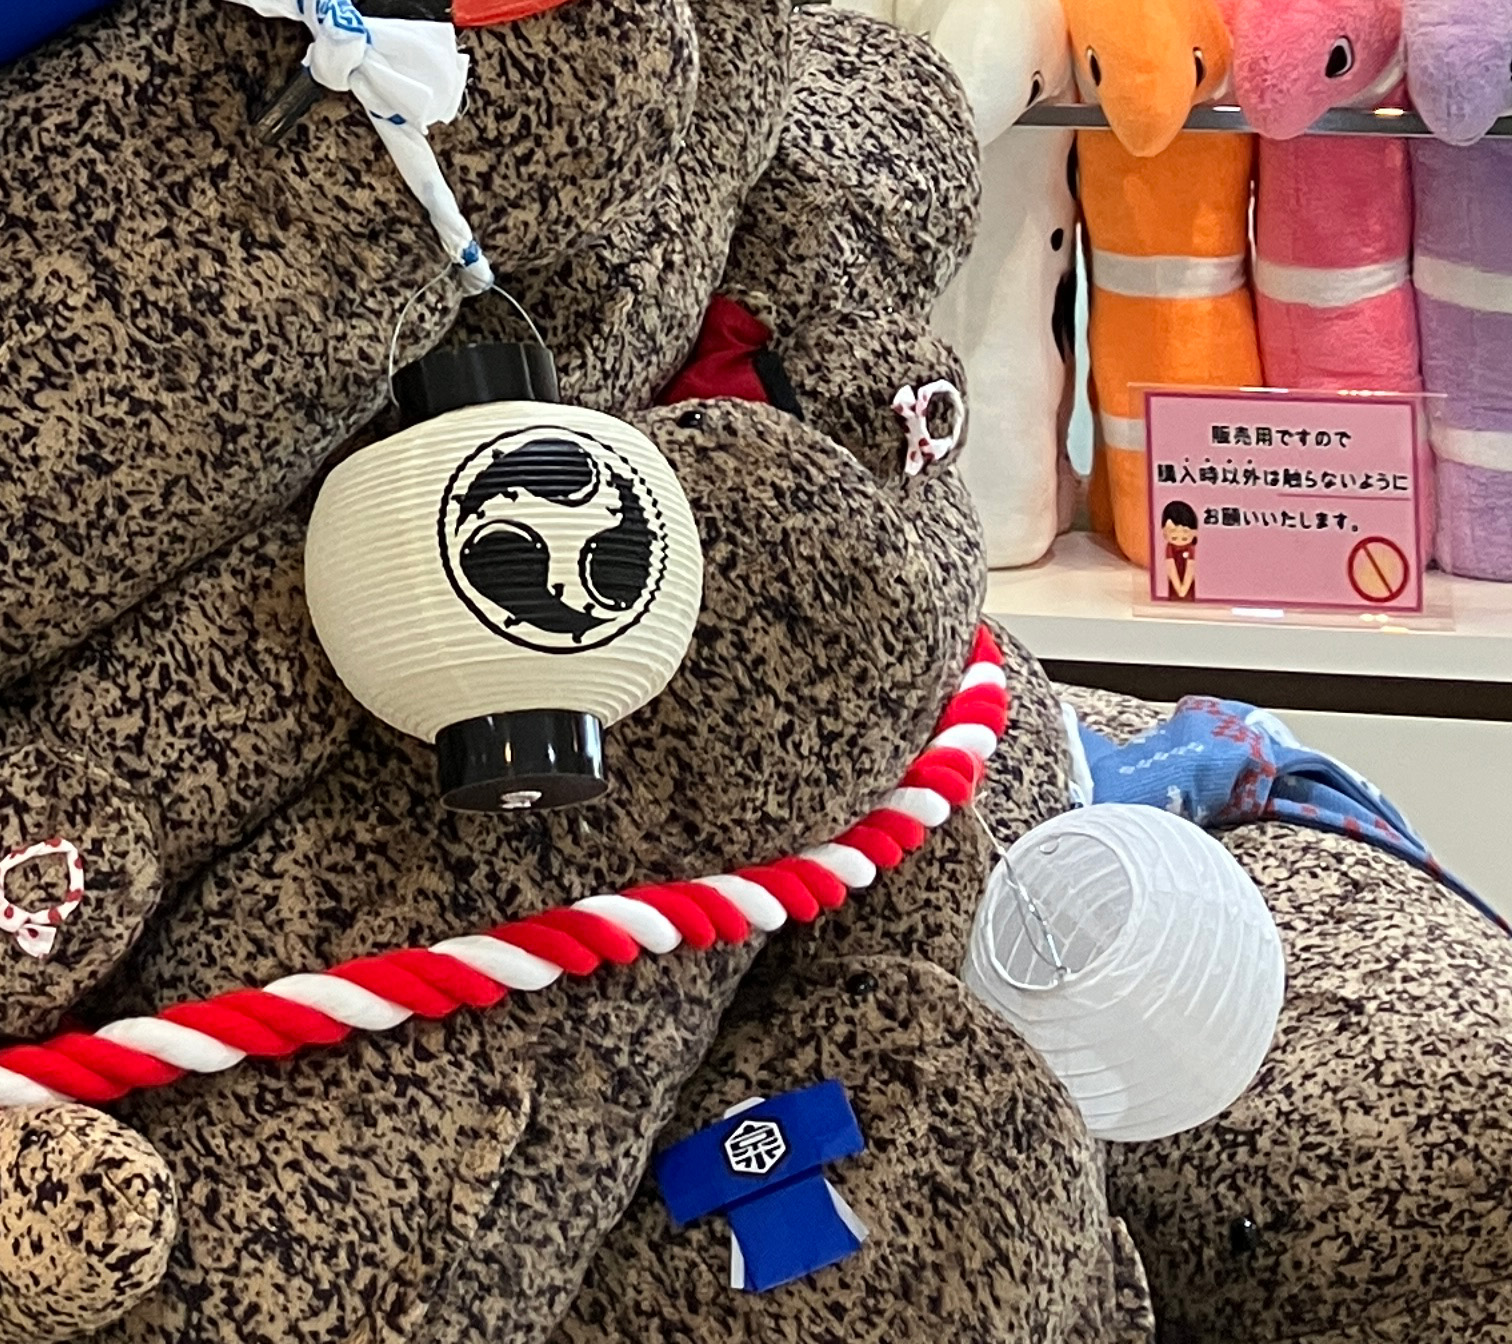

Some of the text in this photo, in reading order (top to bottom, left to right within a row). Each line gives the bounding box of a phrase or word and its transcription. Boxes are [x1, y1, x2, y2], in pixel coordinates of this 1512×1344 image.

[1211, 424, 1352, 448] 販売用ですので
[1156, 463, 1409, 491] 購入時以外は触らないように
[1203, 506, 1359, 532] お願いいたします。
